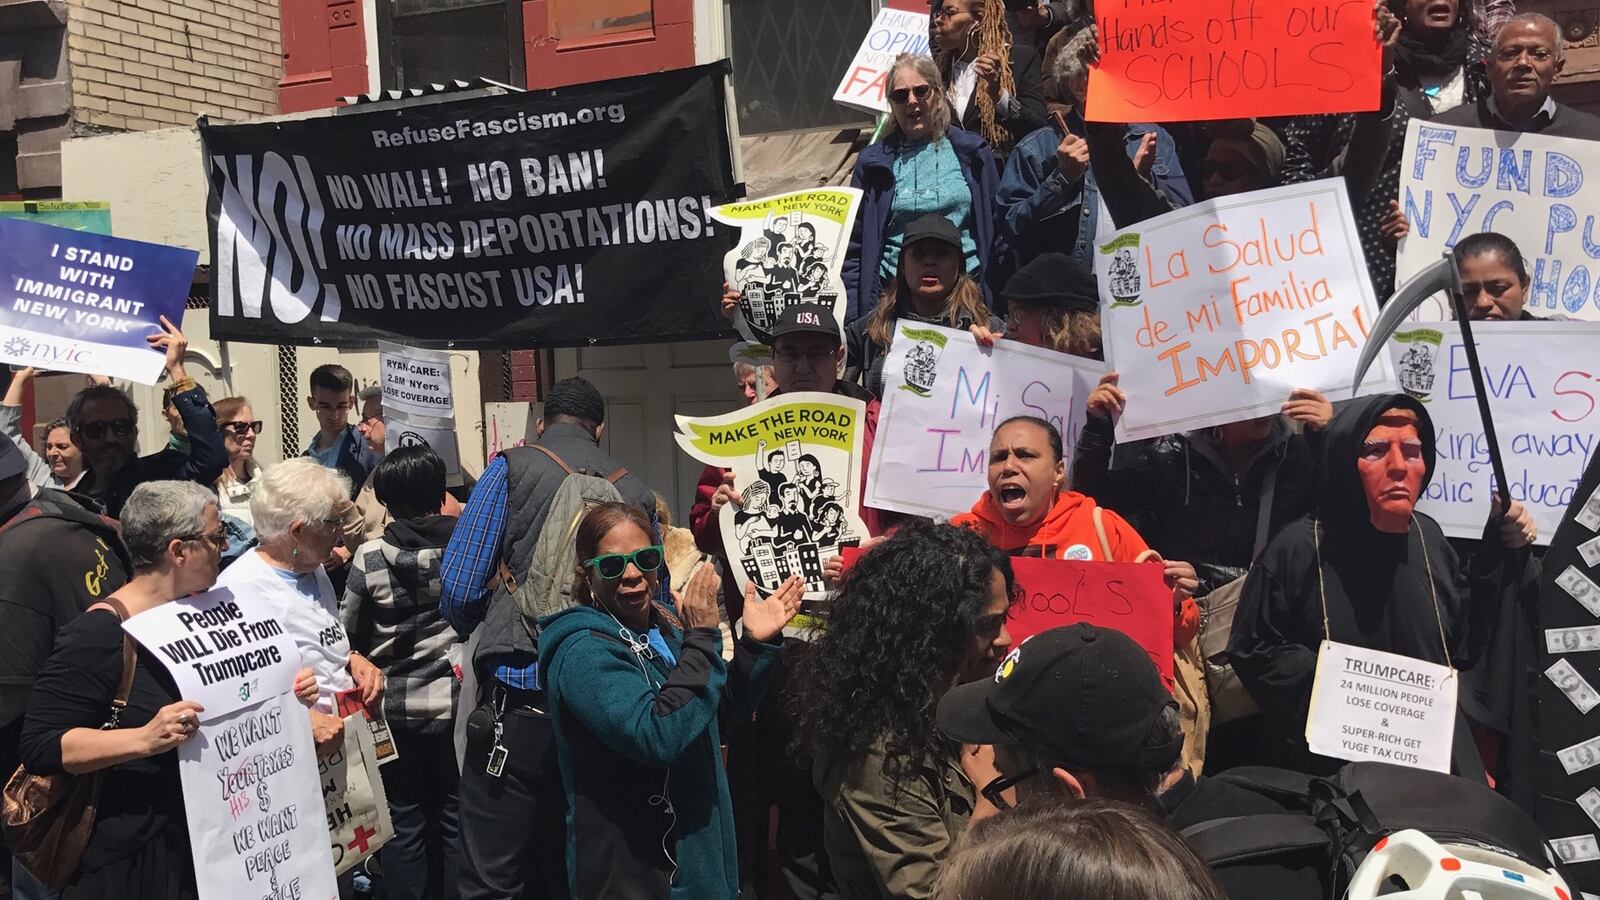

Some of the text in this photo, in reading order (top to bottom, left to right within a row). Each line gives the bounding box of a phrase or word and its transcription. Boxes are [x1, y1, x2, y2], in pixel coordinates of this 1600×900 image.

[1102, 15, 1194, 54] Hands
[1286, 1, 1366, 38] our
[842, 65, 889, 102] FA
[1123, 42, 1354, 109] SCHOOLS
[371, 103, 626, 148] RefuseFascism.org
[326, 149, 608, 210] NO WALL! NO BAN!
[1412, 125, 1584, 198] FUND
[730, 193, 849, 213] MAKE THE ROAD
[783, 202, 845, 217] NEW YORK
[212, 151, 342, 324] NO!
[336, 195, 715, 260] NO MASS DEPORTATIONS!
[1145, 200, 1325, 289] La Salud
[1544, 203, 1600, 259] PU
[51, 243, 134, 272] I STAND
[59, 265, 116, 290] WITH
[345, 263, 586, 310] NO FASCIST USA!
[12, 297, 129, 333] NEW YORK
[15, 277, 145, 316] IMMIGRANT
[1135, 303, 1178, 348] de
[1229, 270, 1333, 327] Familia
[796, 312, 820, 326] USA
[31, 343, 92, 365] nyic
[386, 359, 440, 377] RYAN-CARE:
[383, 385, 450, 406] LOSE COVERAGE
[387, 373, 440, 392] 2.8M NYers
[951, 365, 1001, 431] Mi
[709, 408, 851, 445] MAKE THE ROAD
[773, 425, 849, 443] NEW YORK
[1511, 432, 1594, 476] away
[176, 600, 244, 633] People
[159, 616, 284, 665] WILL Die From
[191, 644, 282, 687] Trumpcare
[1344, 657, 1436, 689] TRUMPCARE:
[1340, 679, 1434, 708] 24 MILLION PEOPLE
[1346, 695, 1426, 721] LOSE COVERAGE
[214, 705, 282, 763] WE WANT
[1341, 724, 1423, 749] SUPER-RICH GET
[1380, 717, 1390, 728] &
[1342, 740, 1419, 764] YUGE TAX CUTS
[232, 803, 298, 855] WE WANT
[245, 839, 292, 882] PEACE
